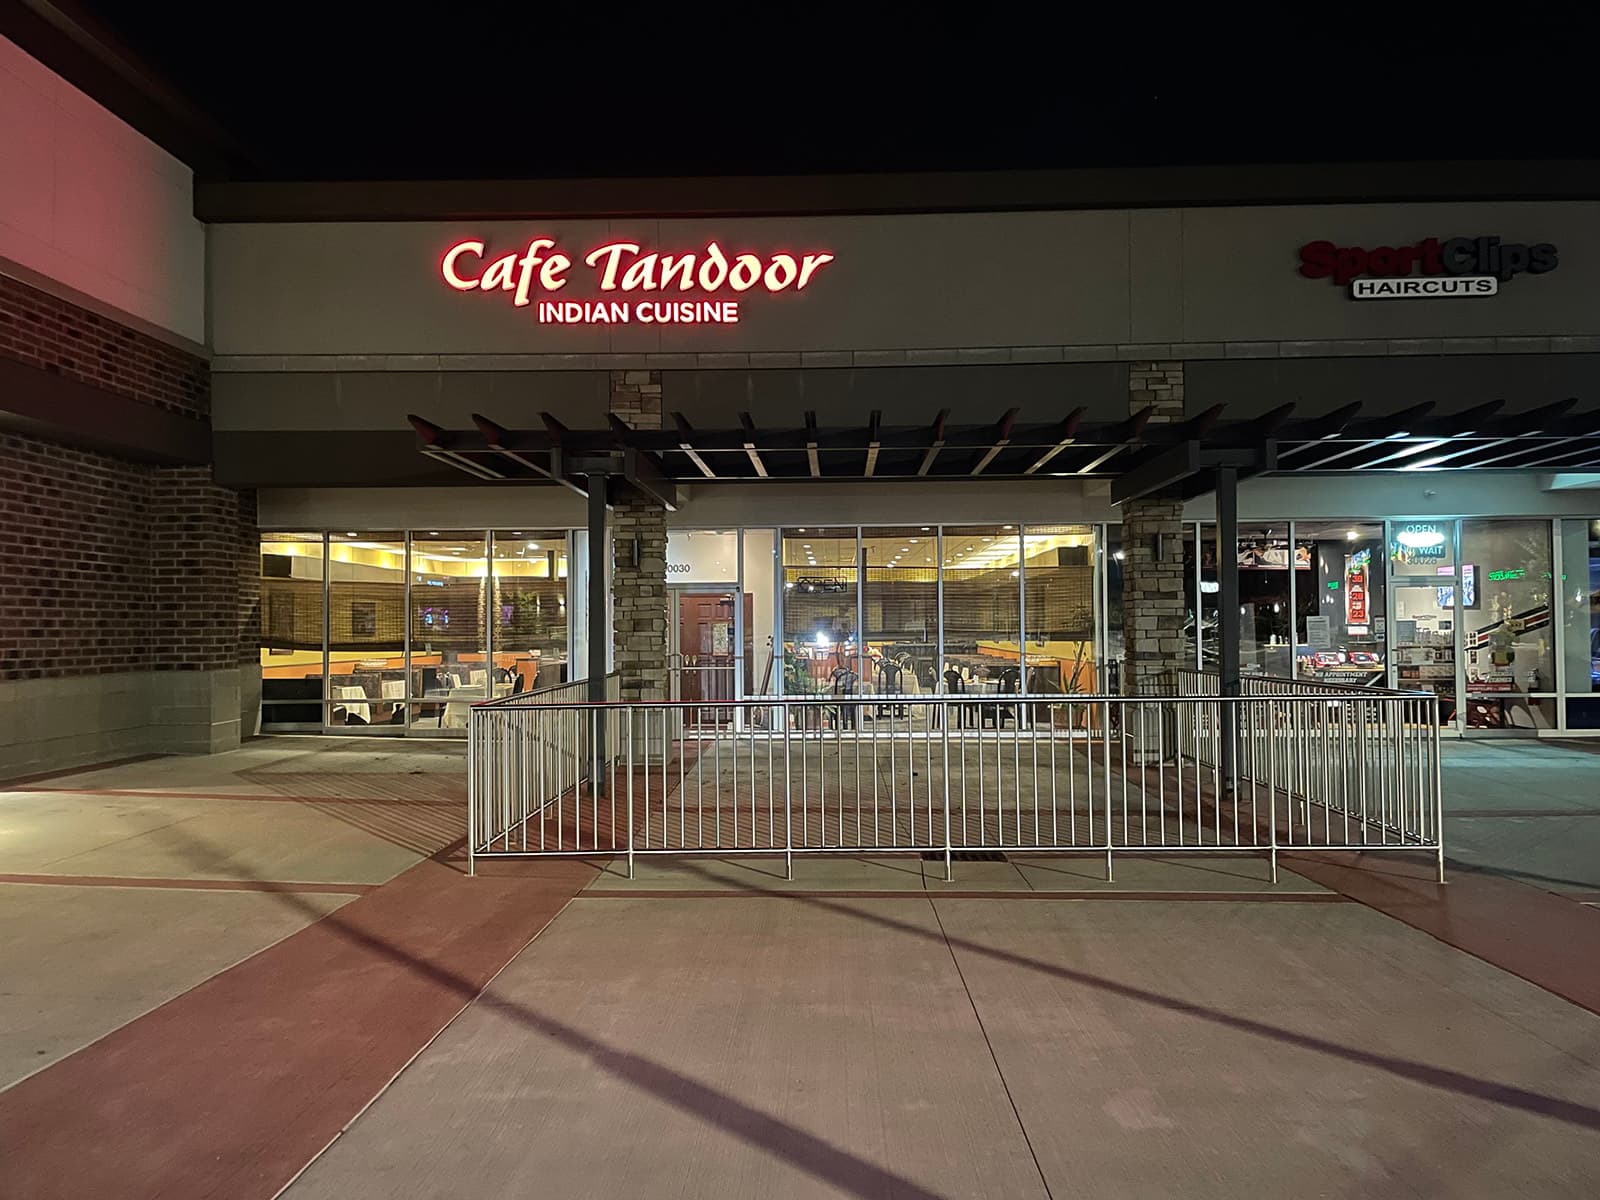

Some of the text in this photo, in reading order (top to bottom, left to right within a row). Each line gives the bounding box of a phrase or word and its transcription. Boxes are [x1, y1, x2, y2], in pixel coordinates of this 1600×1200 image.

[442, 239, 835, 306] Cafe Tandoor
[1358, 279, 1493, 295] HAIRCUTS
[538, 302, 739, 324] INDIAN CUISINE
[1406, 524, 1437, 534] OPEN
[1419, 546, 1444, 555] WAIT
